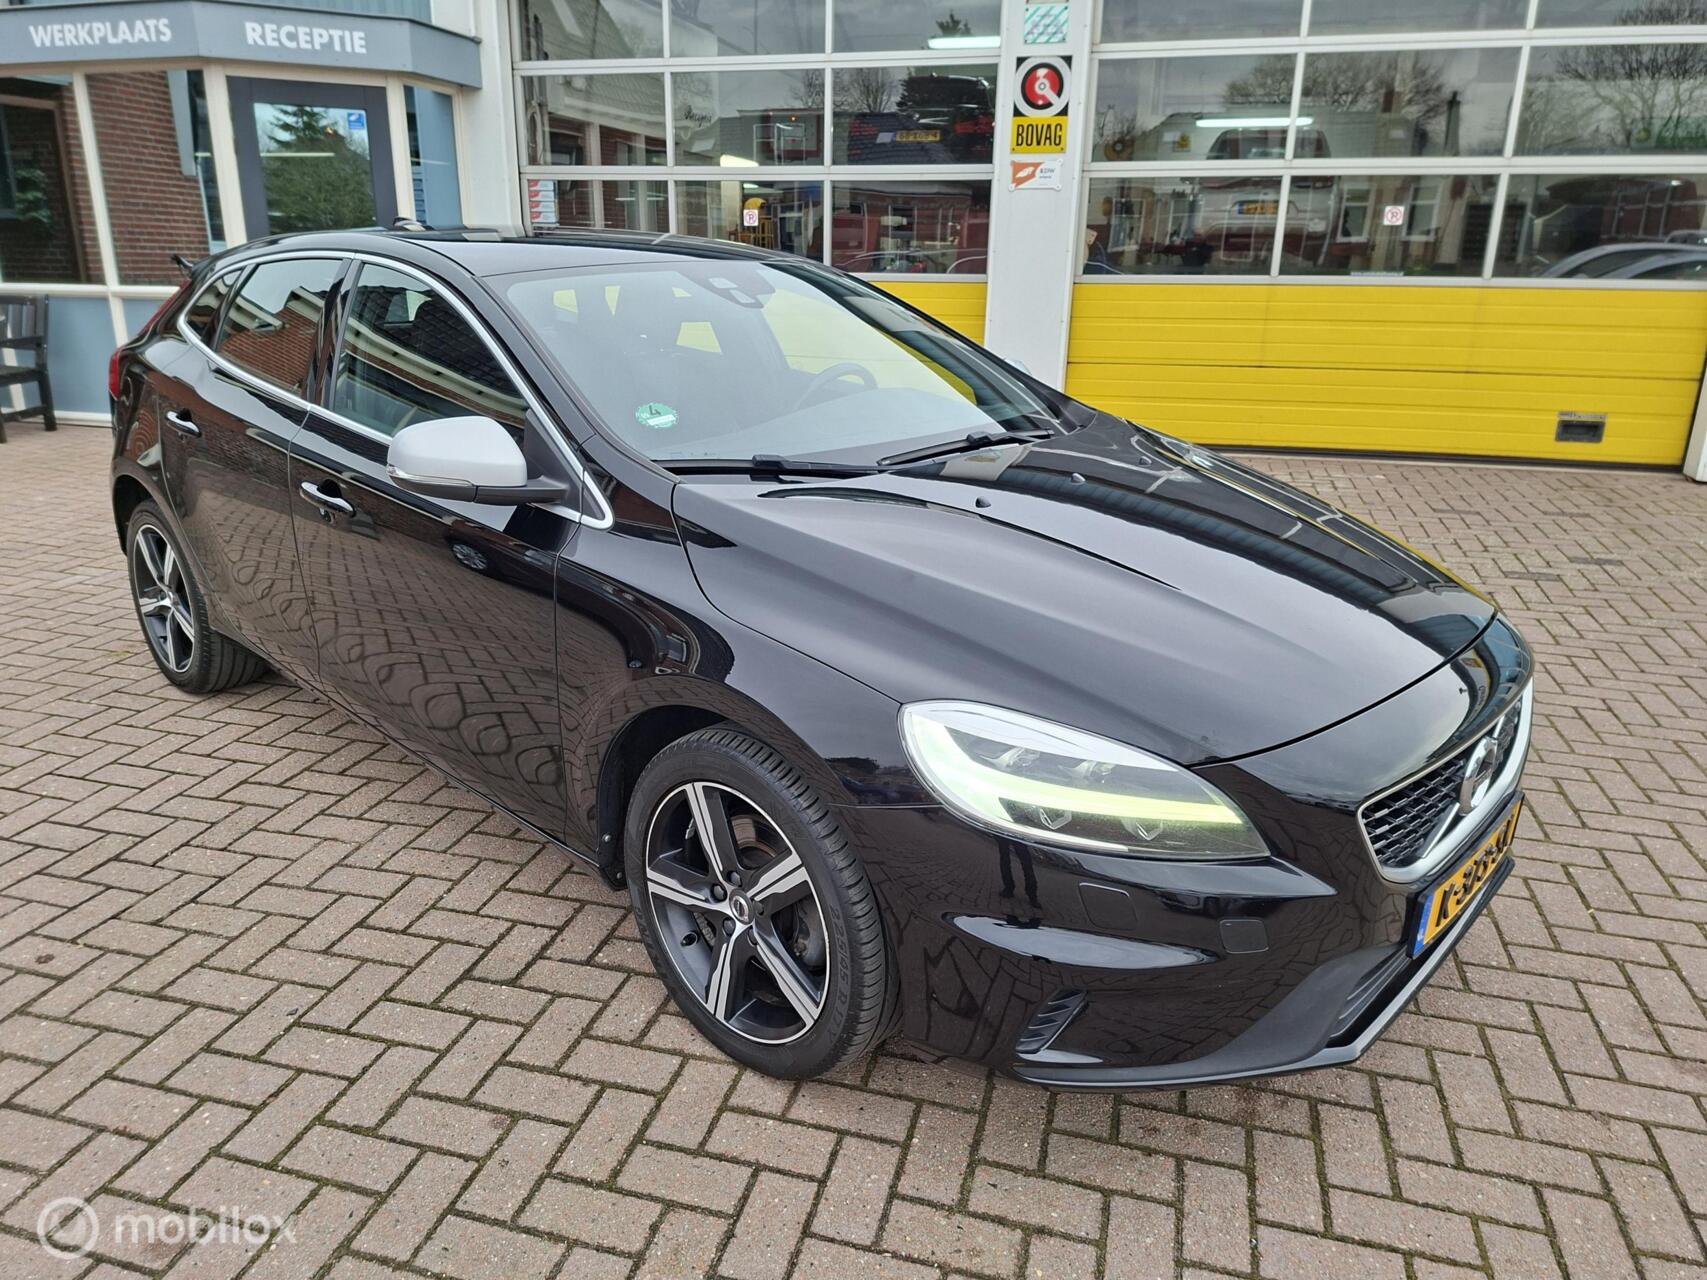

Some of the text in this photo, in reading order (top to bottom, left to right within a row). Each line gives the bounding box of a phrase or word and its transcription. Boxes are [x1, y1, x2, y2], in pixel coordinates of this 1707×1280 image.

[28, 18, 172, 48] WERKPLAATS
[244, 21, 368, 54] RECEPTIE
[1015, 123, 1063, 147] BOVAG
[648, 405, 661, 416] 4
